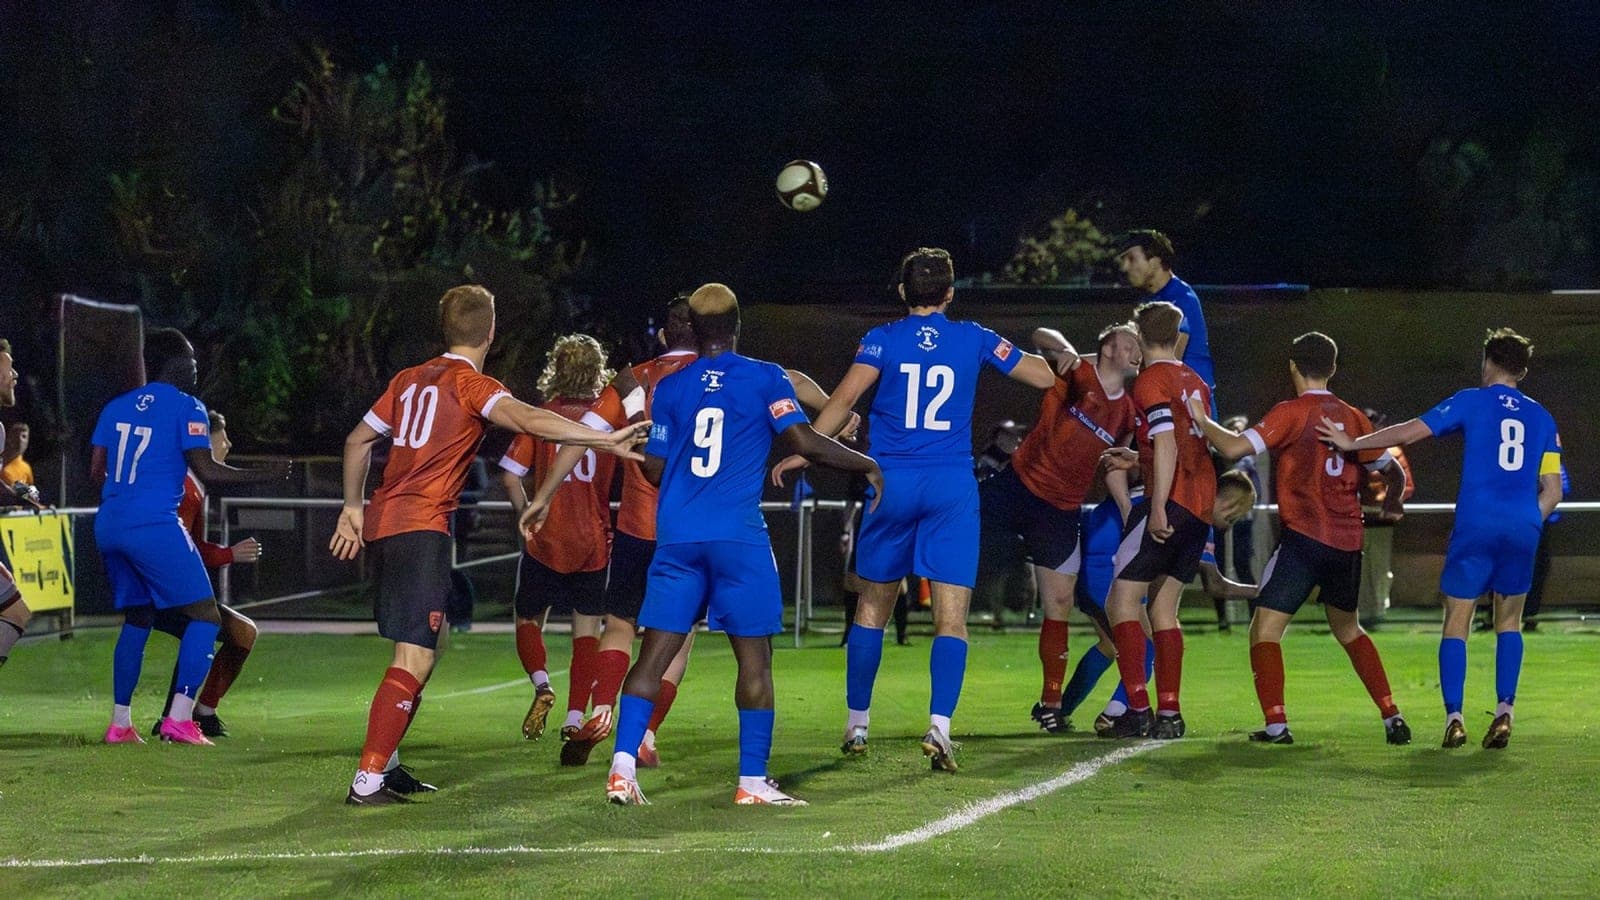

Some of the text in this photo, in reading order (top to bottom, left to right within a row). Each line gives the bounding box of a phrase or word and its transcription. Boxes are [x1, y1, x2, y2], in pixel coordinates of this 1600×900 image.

[393, 383, 439, 449] 10
[900, 363, 955, 431] 12
[116, 422, 152, 485] 17
[690, 407, 725, 478] 9
[1498, 418, 1526, 472] 8
